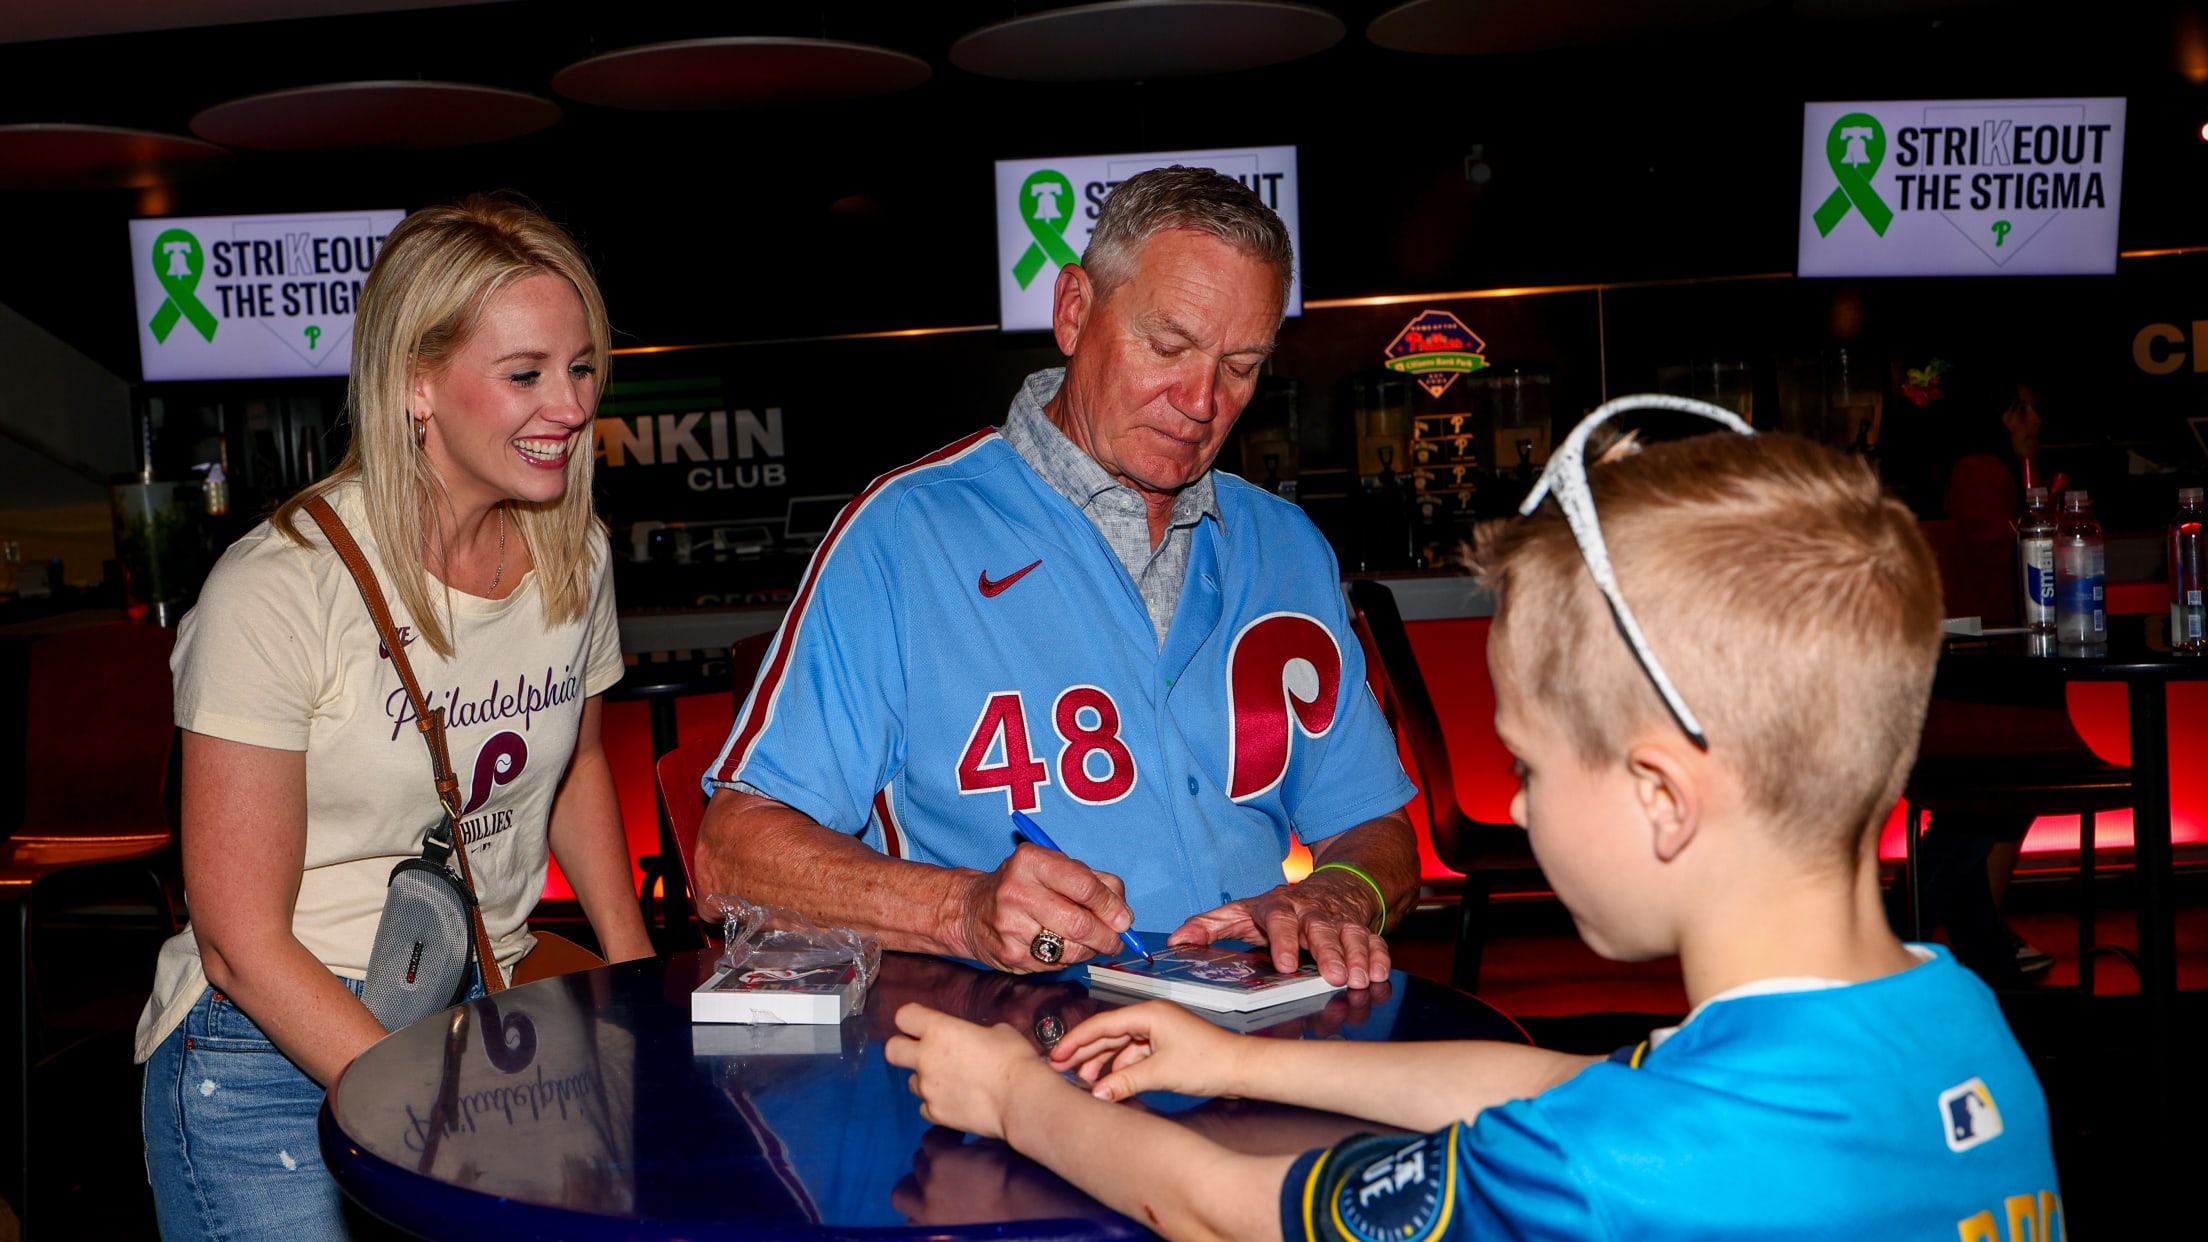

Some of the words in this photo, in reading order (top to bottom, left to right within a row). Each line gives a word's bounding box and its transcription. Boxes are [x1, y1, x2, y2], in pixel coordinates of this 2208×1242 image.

[1895, 119, 2112, 167] STRIKEOUT
[1895, 173, 1961, 211] THE
[1970, 172, 2106, 211] STIGMA
[215, 283, 275, 319] THE
[687, 463, 787, 491] CLUB
[1225, 611, 1342, 801] P
[955, 684, 1138, 816] 48
[460, 809, 513, 846] HILLIES
